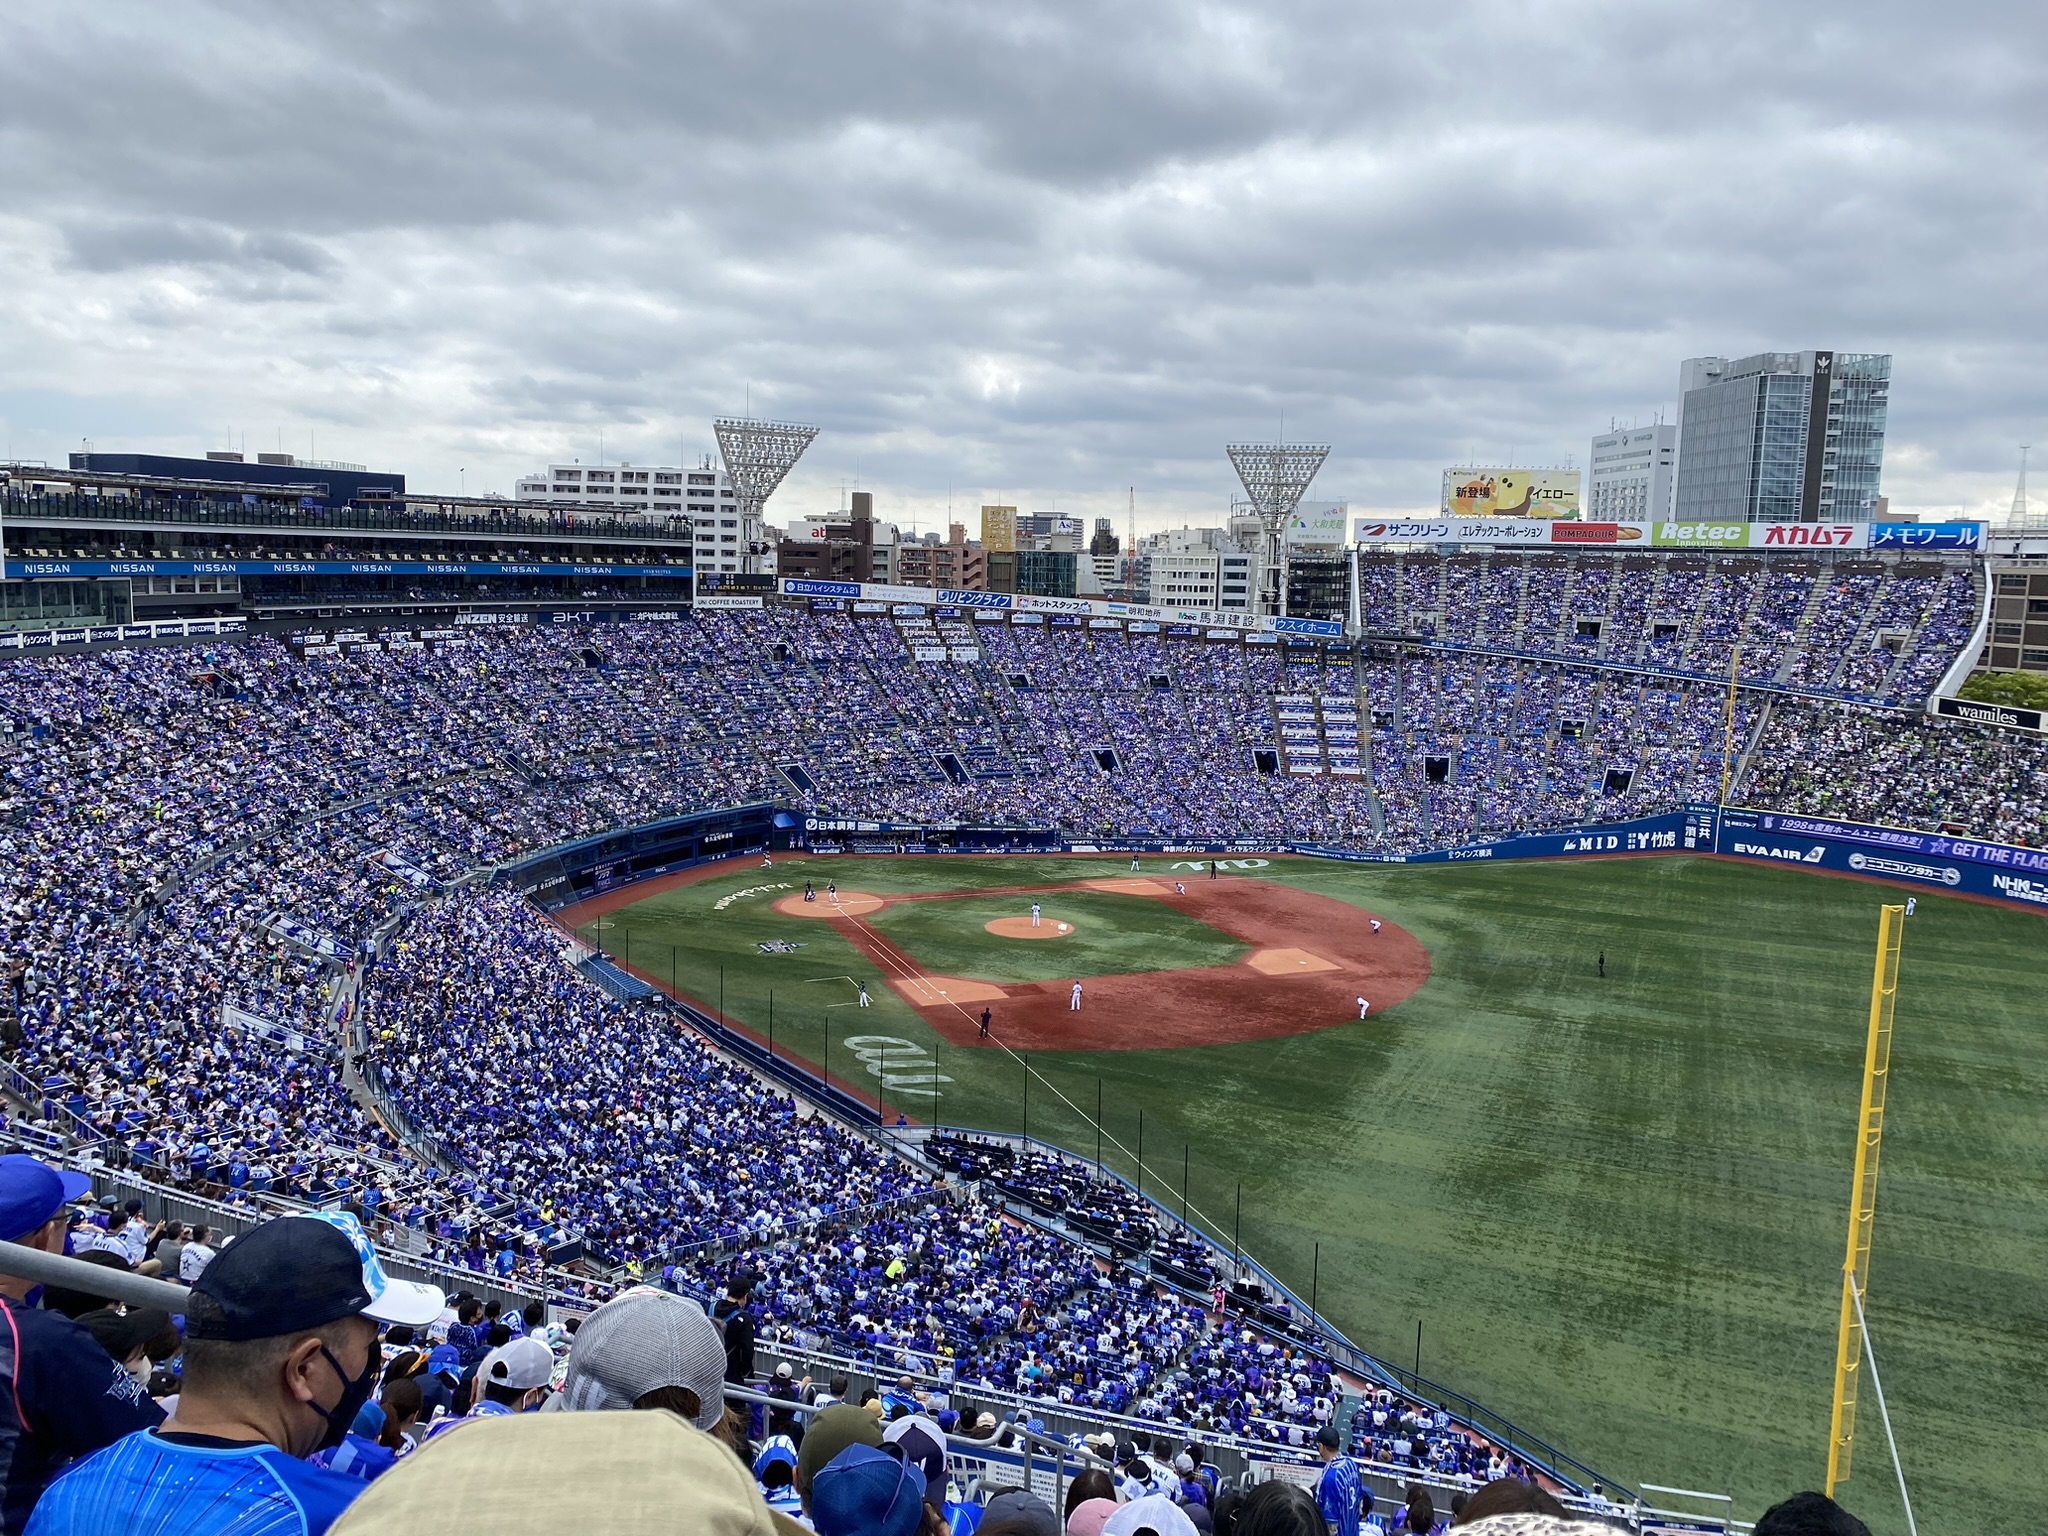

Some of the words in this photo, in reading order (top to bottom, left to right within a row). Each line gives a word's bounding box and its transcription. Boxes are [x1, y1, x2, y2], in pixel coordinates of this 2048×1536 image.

[1455, 486, 1490, 499] 新登場
[1532, 488, 1574, 499] イエロー
[1311, 518, 1345, 530] 大和美建
[1388, 524, 1448, 537] サニクリーン
[1554, 530, 1616, 538] POMPADOUR
[1660, 522, 1741, 540] Retec
[1765, 526, 1854, 545] オカムラ
[1876, 527, 1979, 545] メモワール
[1676, 538, 1723, 547] Innovation
[25, 564, 70, 573] NISSAN
[111, 564, 155, 573] NISSAN
[193, 564, 236, 572] NISSAN
[274, 564, 315, 572] NISSAN
[427, 565, 466, 573] NISSAN
[574, 566, 612, 574] NISSAN
[797, 583, 858, 594] 日立ハイシステム21
[950, 592, 1011, 606] リビングライフ
[1031, 599, 1079, 610] ホットスタッフ
[1128, 606, 1161, 618] 明和地所
[454, 613, 496, 624] ANZEN
[498, 613, 529, 623] 安全輸送
[1277, 619, 1338, 634] ウスイホーム
[1958, 706, 2018, 725] wamiles
[818, 820, 856, 831] 日本調剤
[1579, 835, 1618, 850] MID
[1651, 831, 1676, 848] 竹虎
[1734, 842, 1769, 856] EVA
[1769, 847, 1801, 860] AIR
[1952, 842, 1982, 858] GET
[1984, 846, 2011, 863] THE
[2012, 851, 2048, 870] FLAG
[1867, 859, 1942, 877] ニコニコレンタカー
